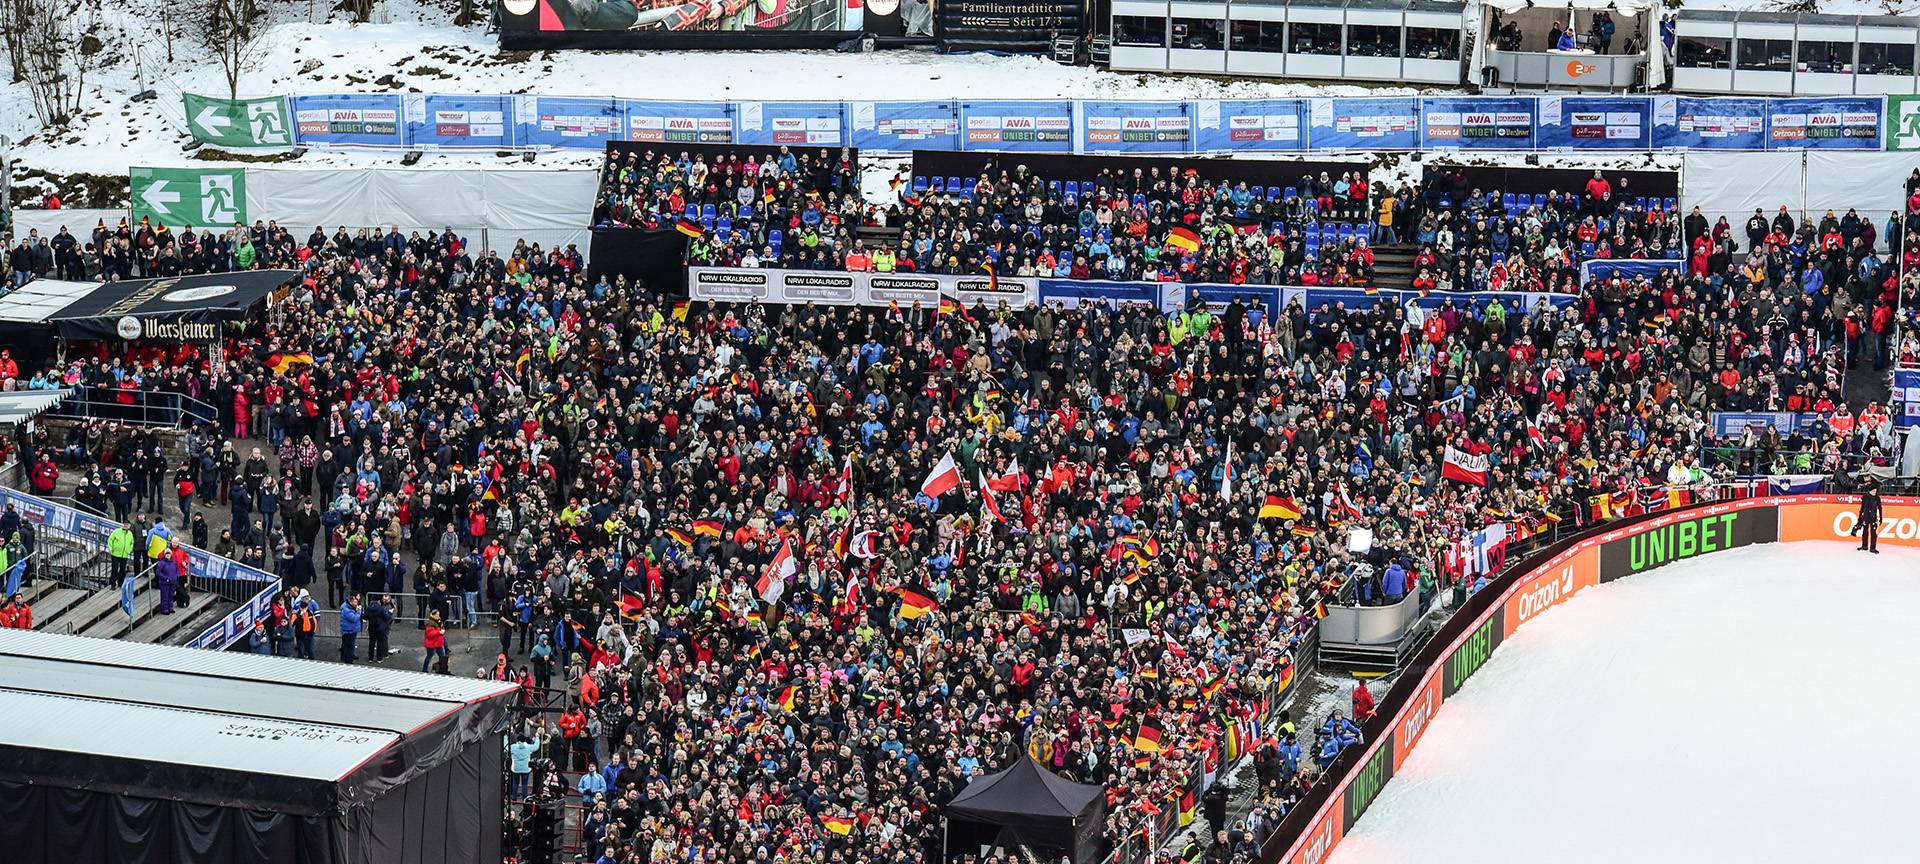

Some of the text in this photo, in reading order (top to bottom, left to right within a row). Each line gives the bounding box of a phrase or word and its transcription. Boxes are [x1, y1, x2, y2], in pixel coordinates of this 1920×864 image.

[1013, 17, 1062, 27] Seit 173
[1466, 114, 1491, 123] AVIA
[1812, 115, 1836, 124] AVIA
[666, 132, 697, 140] UNIBET
[1003, 132, 1034, 140] UNIBET
[1123, 132, 1153, 140] UNIBET
[1429, 128, 1452, 136] Orizon
[1463, 128, 1493, 136] UNIBET
[1808, 128, 1839, 136] UNIBET
[719, 275, 764, 283] LOKALRADIOS
[805, 278, 850, 286] LOKALRADIOS
[892, 281, 936, 289] LOKALRADIOS
[145, 317, 216, 341] Warsteiner
[1631, 512, 1737, 571] UNIBET
[1519, 579, 1559, 621] Orizon
[1453, 617, 1493, 688] UNIBET
[1405, 703, 1425, 749] Orizon
[1353, 744, 1385, 818] UNIBET
